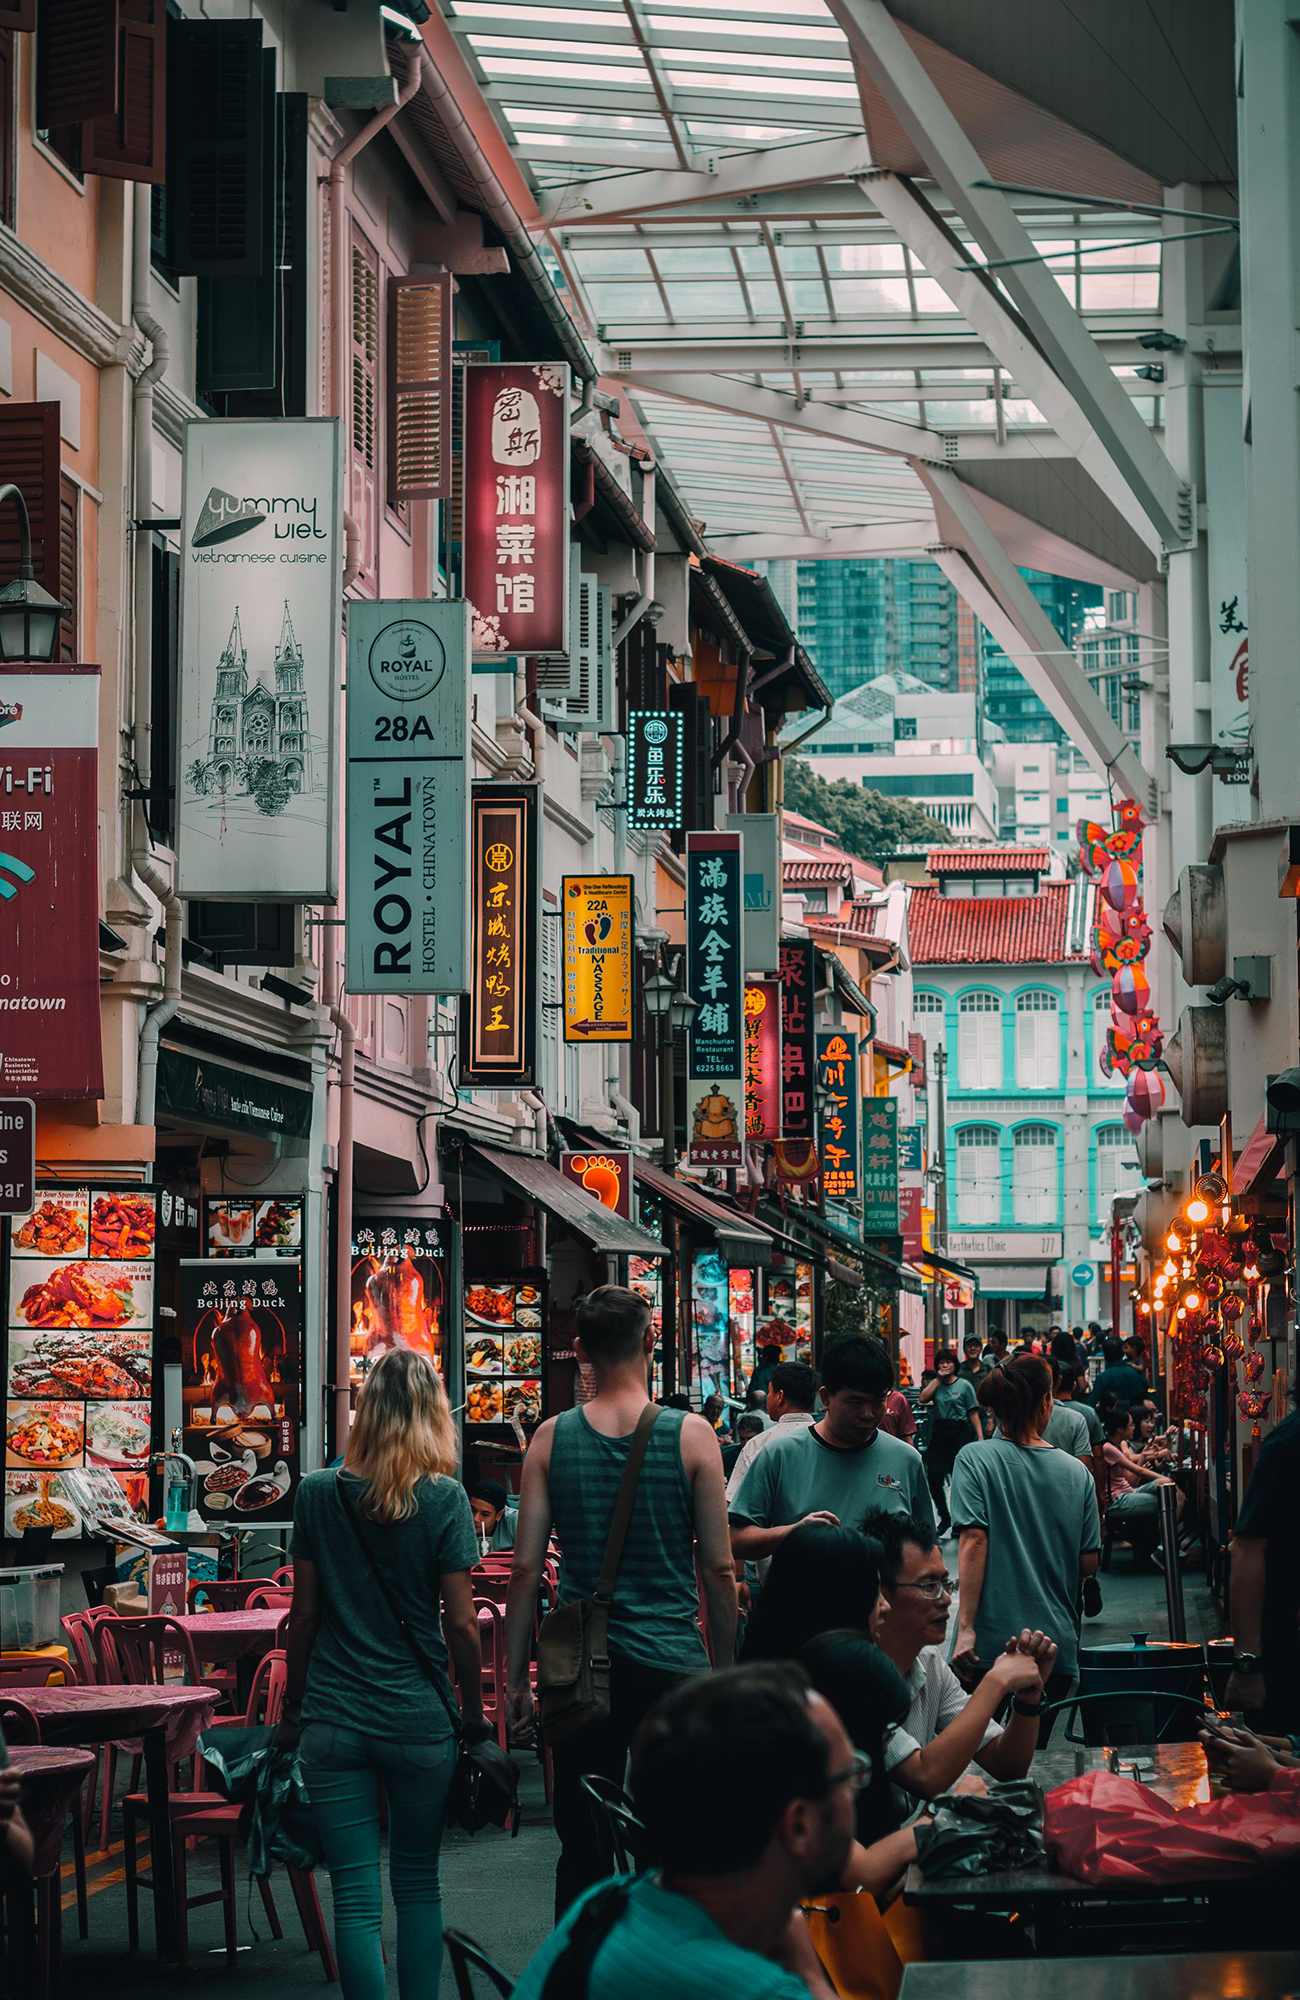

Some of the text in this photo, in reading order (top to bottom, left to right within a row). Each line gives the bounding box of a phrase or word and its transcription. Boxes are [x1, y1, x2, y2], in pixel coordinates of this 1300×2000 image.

[209, 497, 318, 520] yummy
[496, 475, 536, 613] 湘菜馆
[191, 548, 327, 563] vietnamese cuisine
[381, 659, 433, 673] ROYAL
[374, 715, 435, 742] 28A
[644, 746, 667, 804] 鱼乐乐
[1227, 772, 1249, 782] roo
[1, 811, 44, 831] 联网
[373, 777, 412, 974] ROYAL
[422, 776, 436, 974] HOSTEL CHINATOWN
[587, 900, 608, 911] 22A
[577, 946, 620, 955] Traditional
[591, 954, 605, 1021] MASSAGE
[706, 1055, 724, 1063] TEL:
[43, 1190, 57, 1198] Sour
[57, 1190, 75, 1199] Spare
[75, 1191, 88, 1199] Ribs
[866, 1190, 896, 1203] CI YAN
[867, 1210, 896, 1219] VEGETARIAN
[987, 1236, 1007, 1252] Clinic
[1041, 1237, 1055, 1253] 277
[350, 1246, 445, 1258] Beijing Duck
[486, 1275, 509, 1283] Cuisine
[197, 1298, 286, 1310] Beijing Duck
